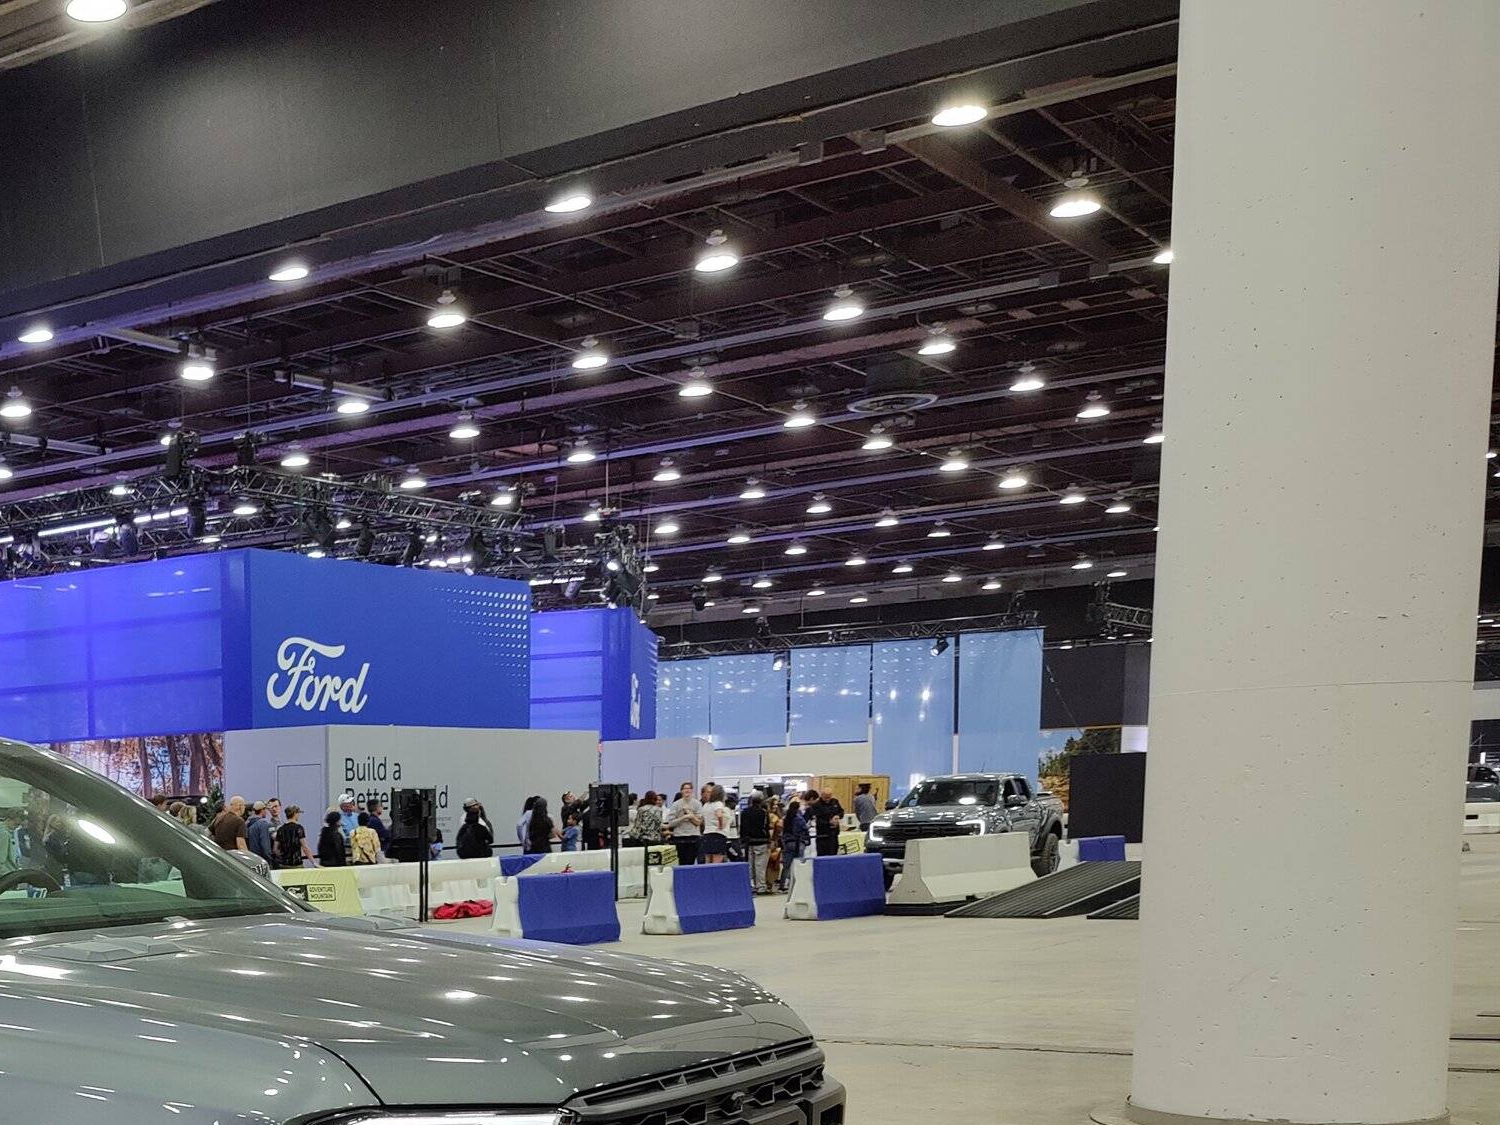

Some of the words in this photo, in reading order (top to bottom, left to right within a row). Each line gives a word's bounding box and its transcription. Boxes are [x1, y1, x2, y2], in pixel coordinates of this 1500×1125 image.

[266, 636, 371, 714] Ford
[344, 756, 387, 783] Build
[392, 761, 402, 783] a
[344, 787, 391, 811] Bette
